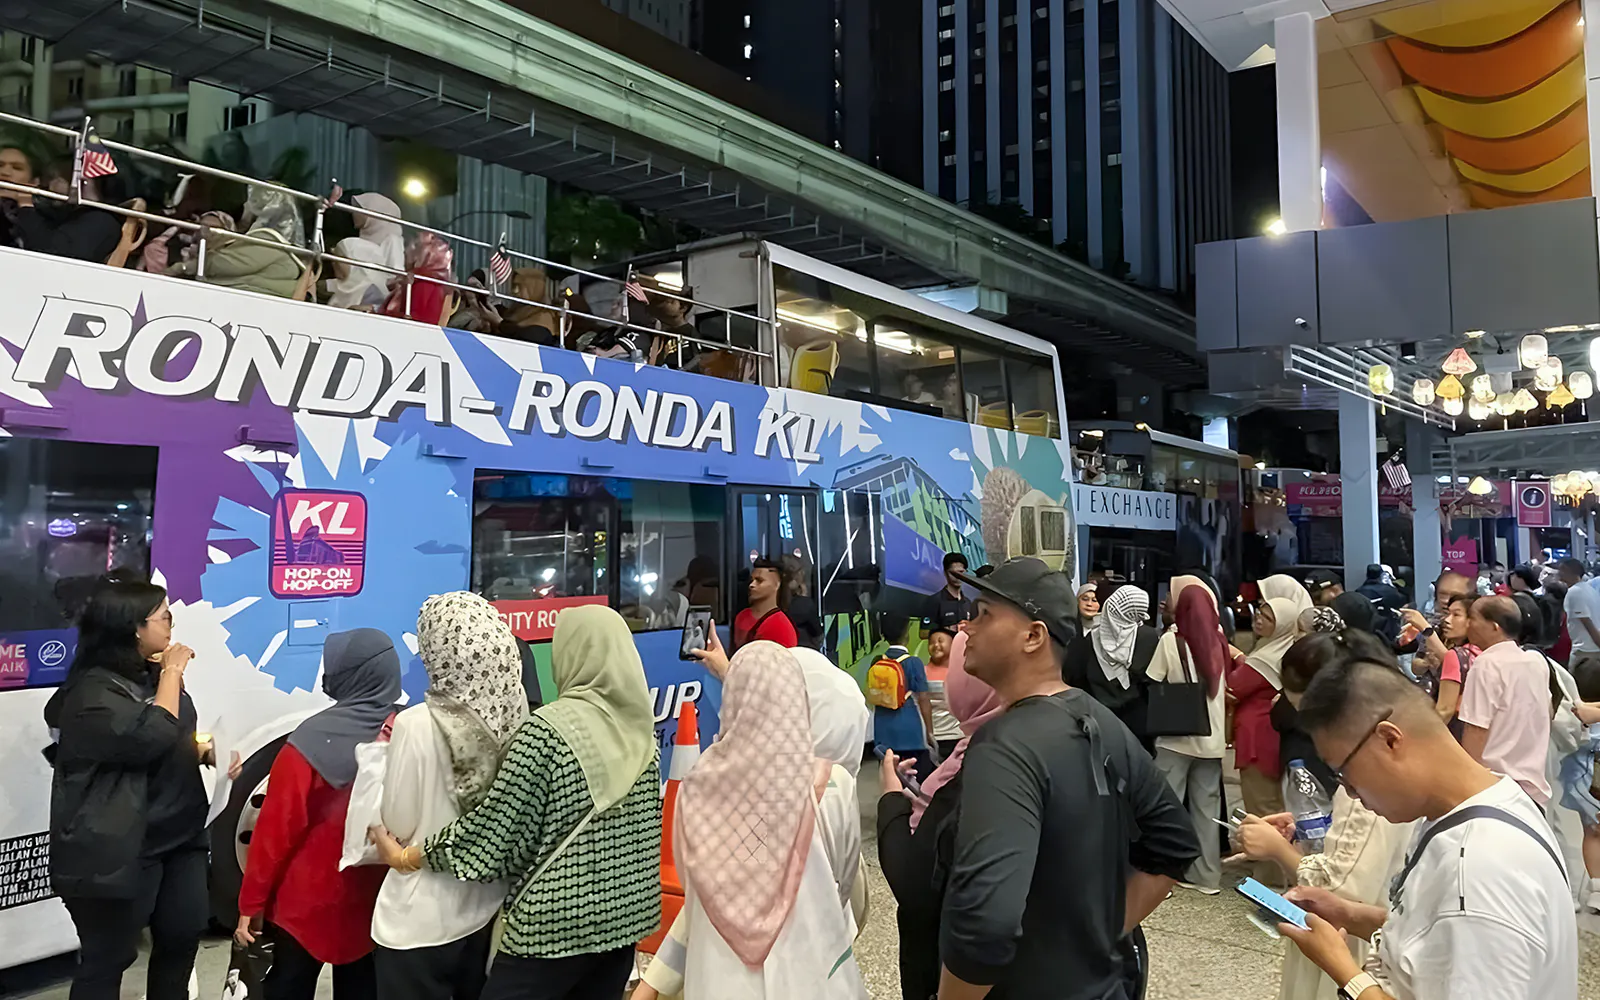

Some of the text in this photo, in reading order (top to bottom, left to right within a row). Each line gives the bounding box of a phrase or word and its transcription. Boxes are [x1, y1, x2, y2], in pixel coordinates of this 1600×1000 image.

[507, 369, 735, 453] RONDA
[753, 408, 823, 463] KL
[1090, 490, 1171, 519] EXCHANGE
[290, 500, 357, 535] KL
[284, 568, 351, 579] HOP-ON
[283, 579, 354, 590] HOP-OFF
[0, 644, 26, 658] ME
[19, 856, 50, 870] JALAN
[31, 866, 50, 879] PUL
